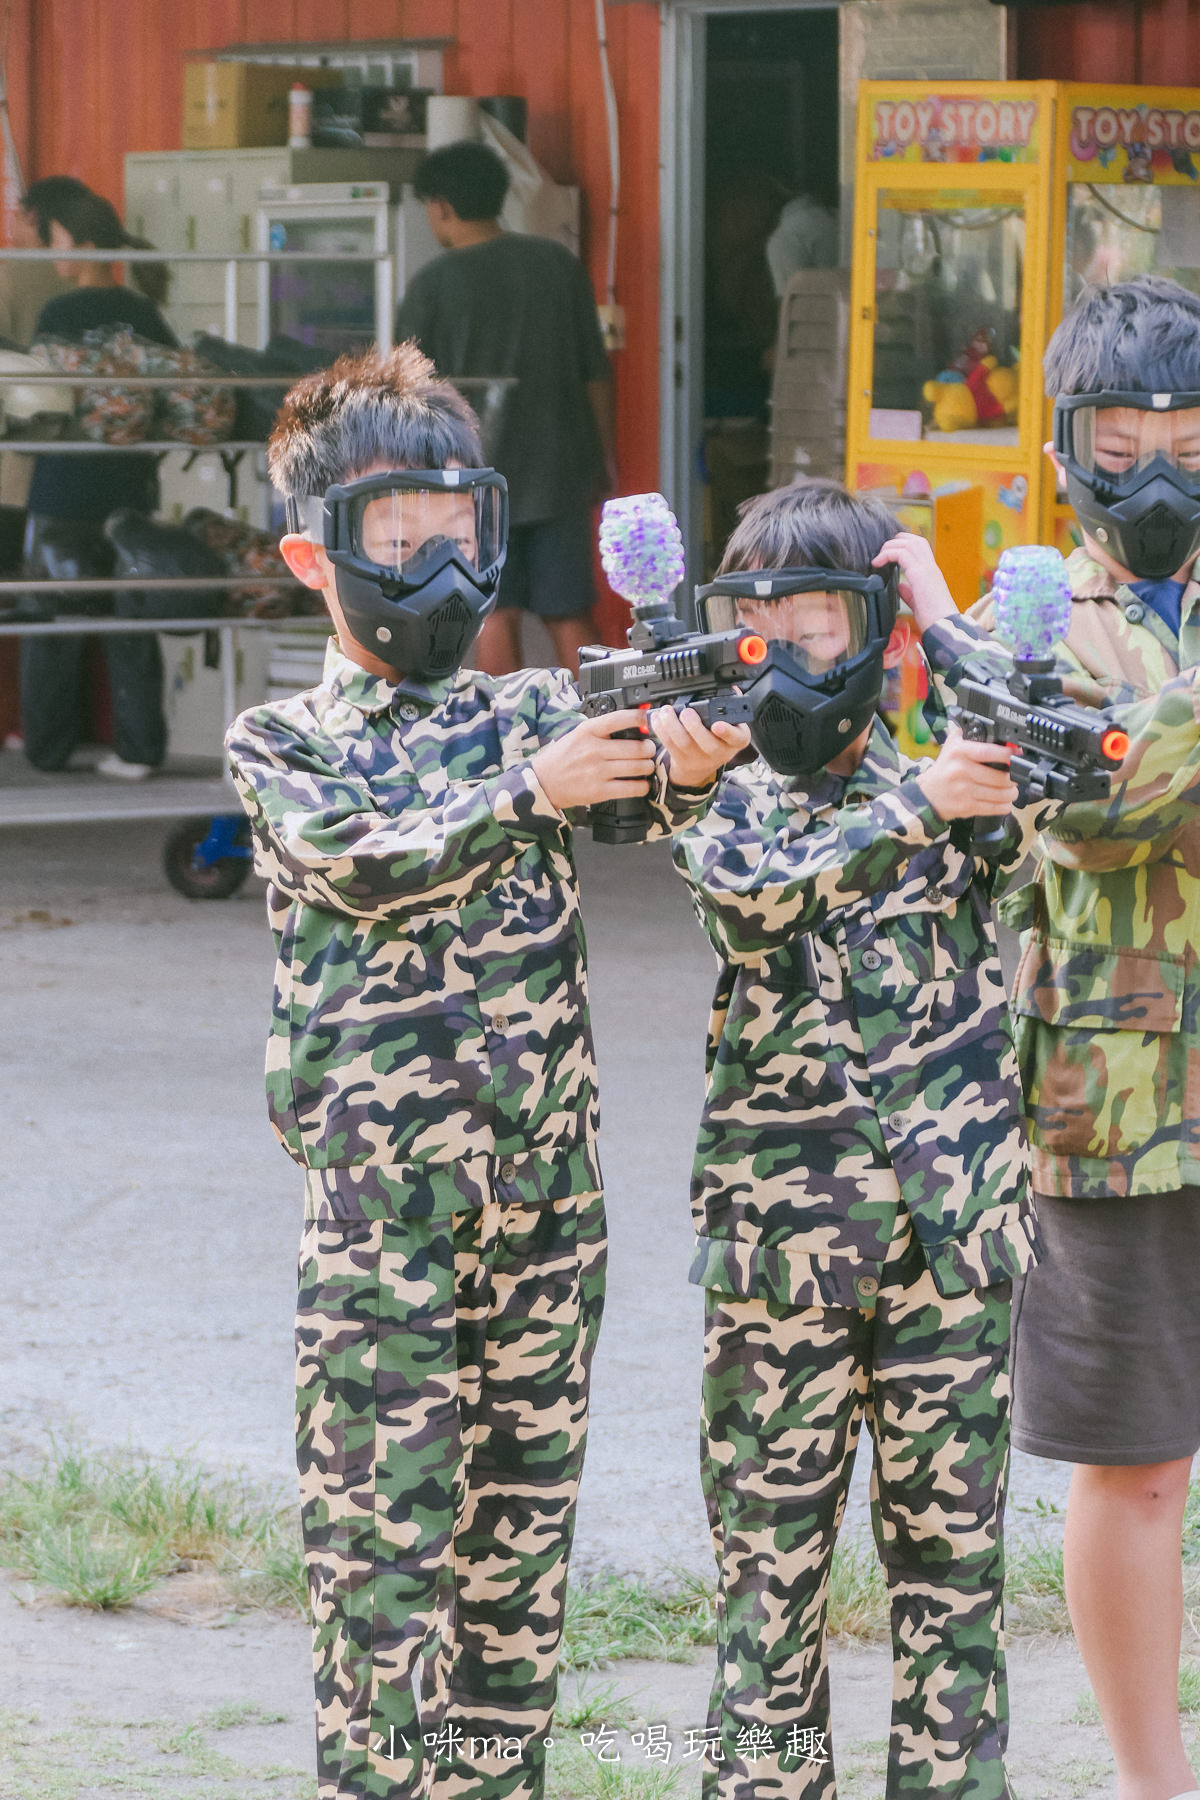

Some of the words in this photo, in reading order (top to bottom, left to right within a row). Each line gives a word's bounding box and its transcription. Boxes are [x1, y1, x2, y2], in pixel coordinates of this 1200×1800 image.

[876, 100, 936, 145] TOY
[940, 100, 1037, 146] STORY
[1073, 106, 1140, 147] TOY
